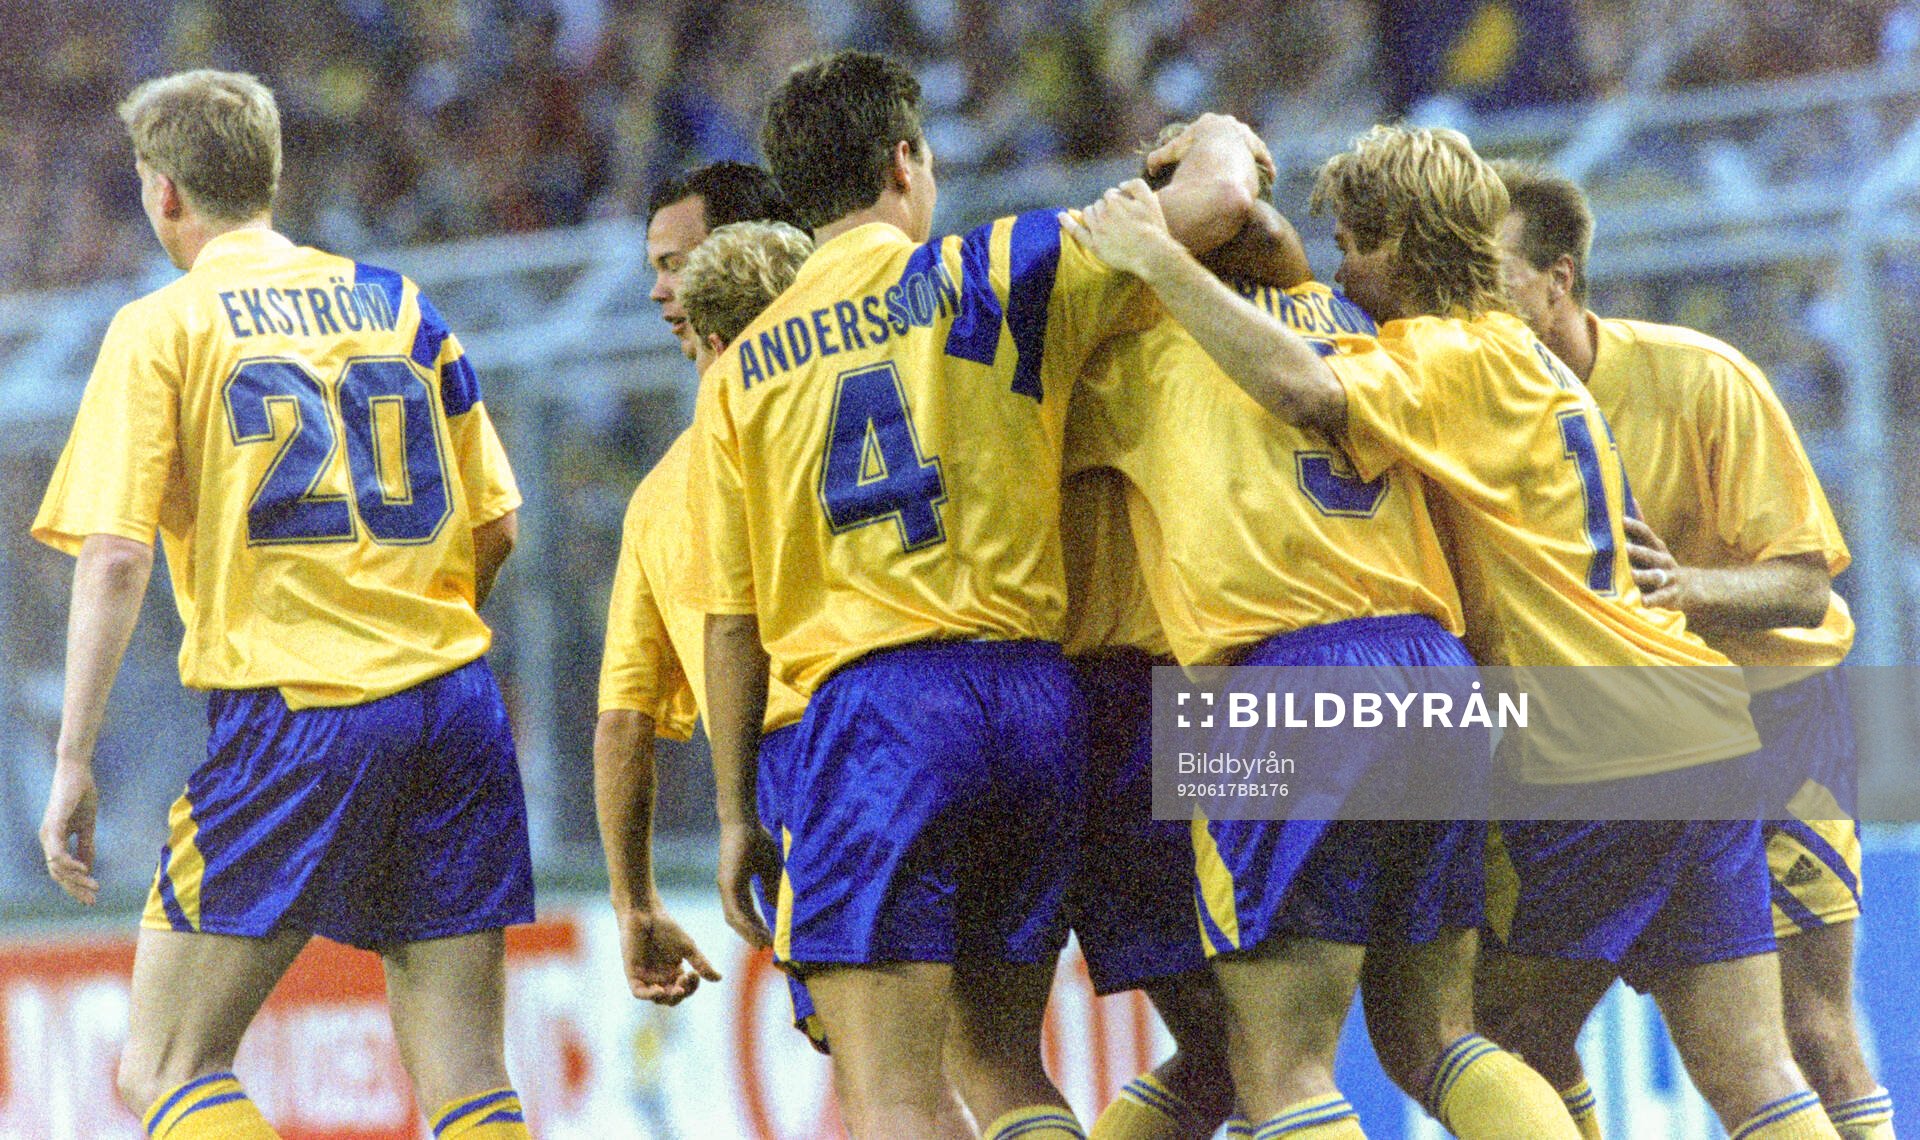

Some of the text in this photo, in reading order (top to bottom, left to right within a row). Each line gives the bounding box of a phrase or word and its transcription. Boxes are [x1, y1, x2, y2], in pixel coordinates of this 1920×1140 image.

[219, 276, 396, 338] EKSTRÖM
[738, 262, 962, 391] ANDERSSON
[221, 355, 455, 548] 20
[817, 359, 949, 553] 4
